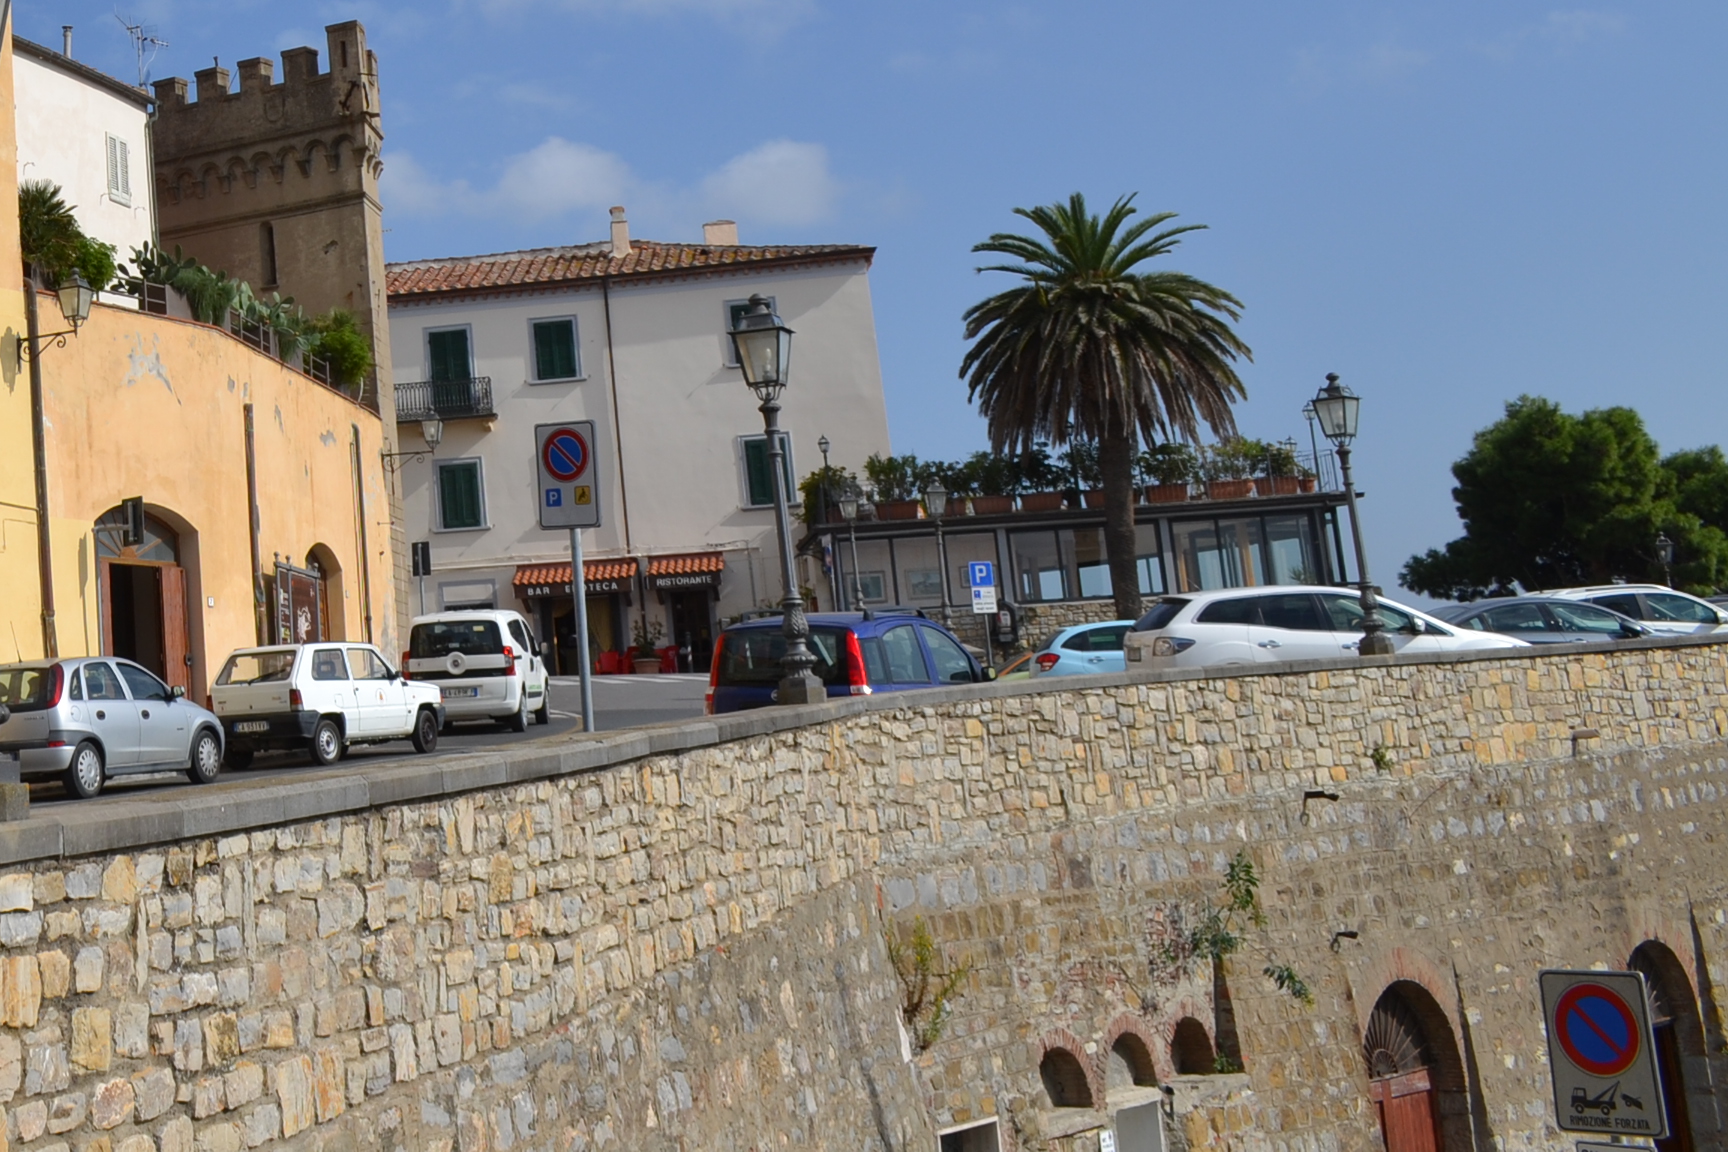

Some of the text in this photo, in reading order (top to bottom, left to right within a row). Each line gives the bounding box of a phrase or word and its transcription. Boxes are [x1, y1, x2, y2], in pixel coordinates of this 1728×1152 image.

[549, 491, 558, 505] P
[656, 574, 712, 587] RISTORANTE
[974, 564, 987, 584] P
[527, 581, 618, 596] BAR ETECA
[1569, 1114, 1651, 1130] RIMOZIONE FORZATA
